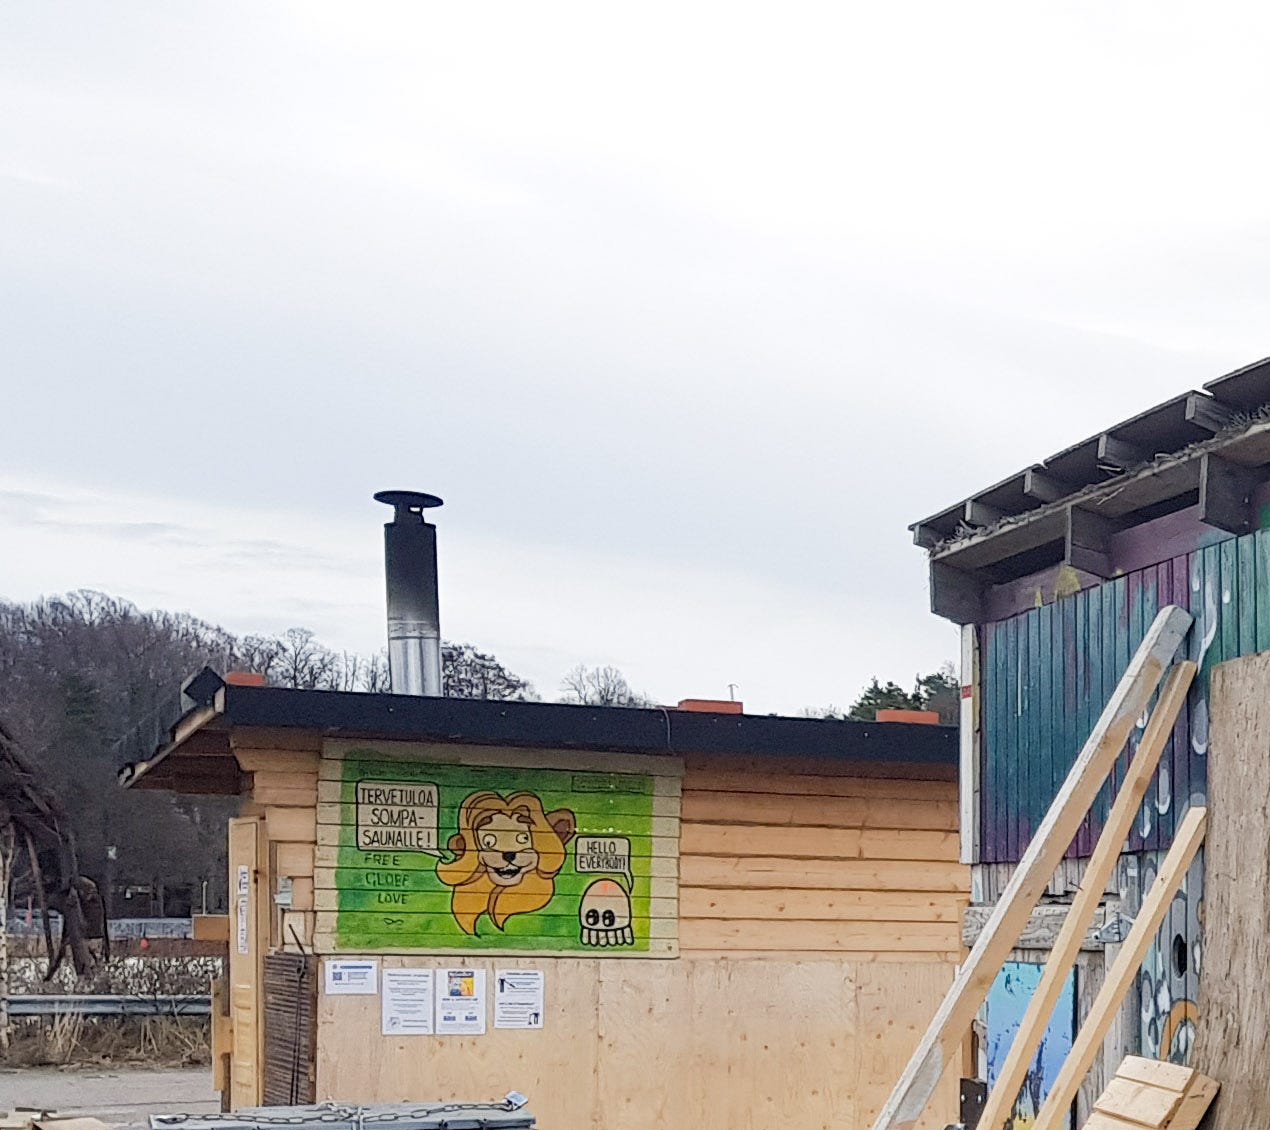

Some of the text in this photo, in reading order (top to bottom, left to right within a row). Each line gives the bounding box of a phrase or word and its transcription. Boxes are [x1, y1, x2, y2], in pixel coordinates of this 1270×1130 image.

[359, 787, 435, 805] TERVETULOA
[371, 807, 425, 827] SOMPA-
[586, 840, 617, 855] HELLO
[364, 852, 401, 867] FREE
[377, 892, 409, 905] LOVE
